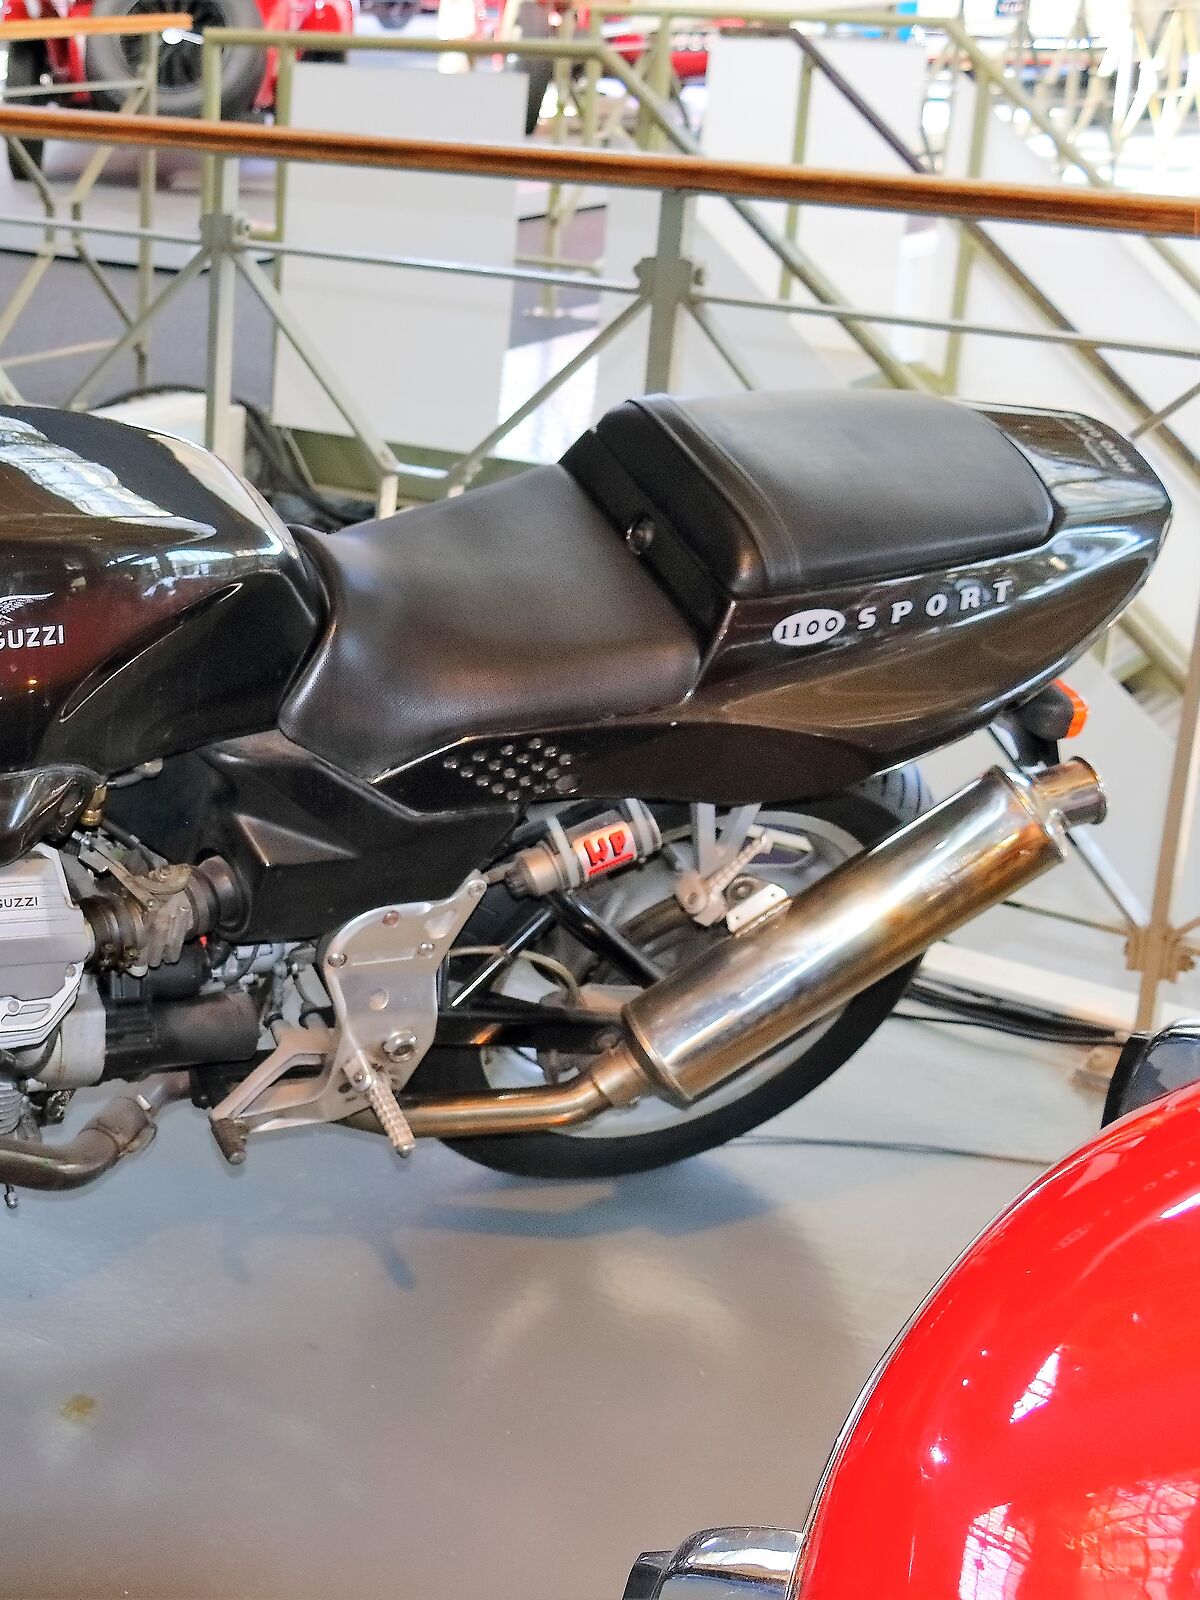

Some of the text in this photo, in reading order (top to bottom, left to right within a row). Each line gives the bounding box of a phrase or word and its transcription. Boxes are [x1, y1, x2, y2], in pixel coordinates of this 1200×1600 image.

[779, 578, 1014, 640] 1100 SPORT
[583, 829, 626, 867] WP
